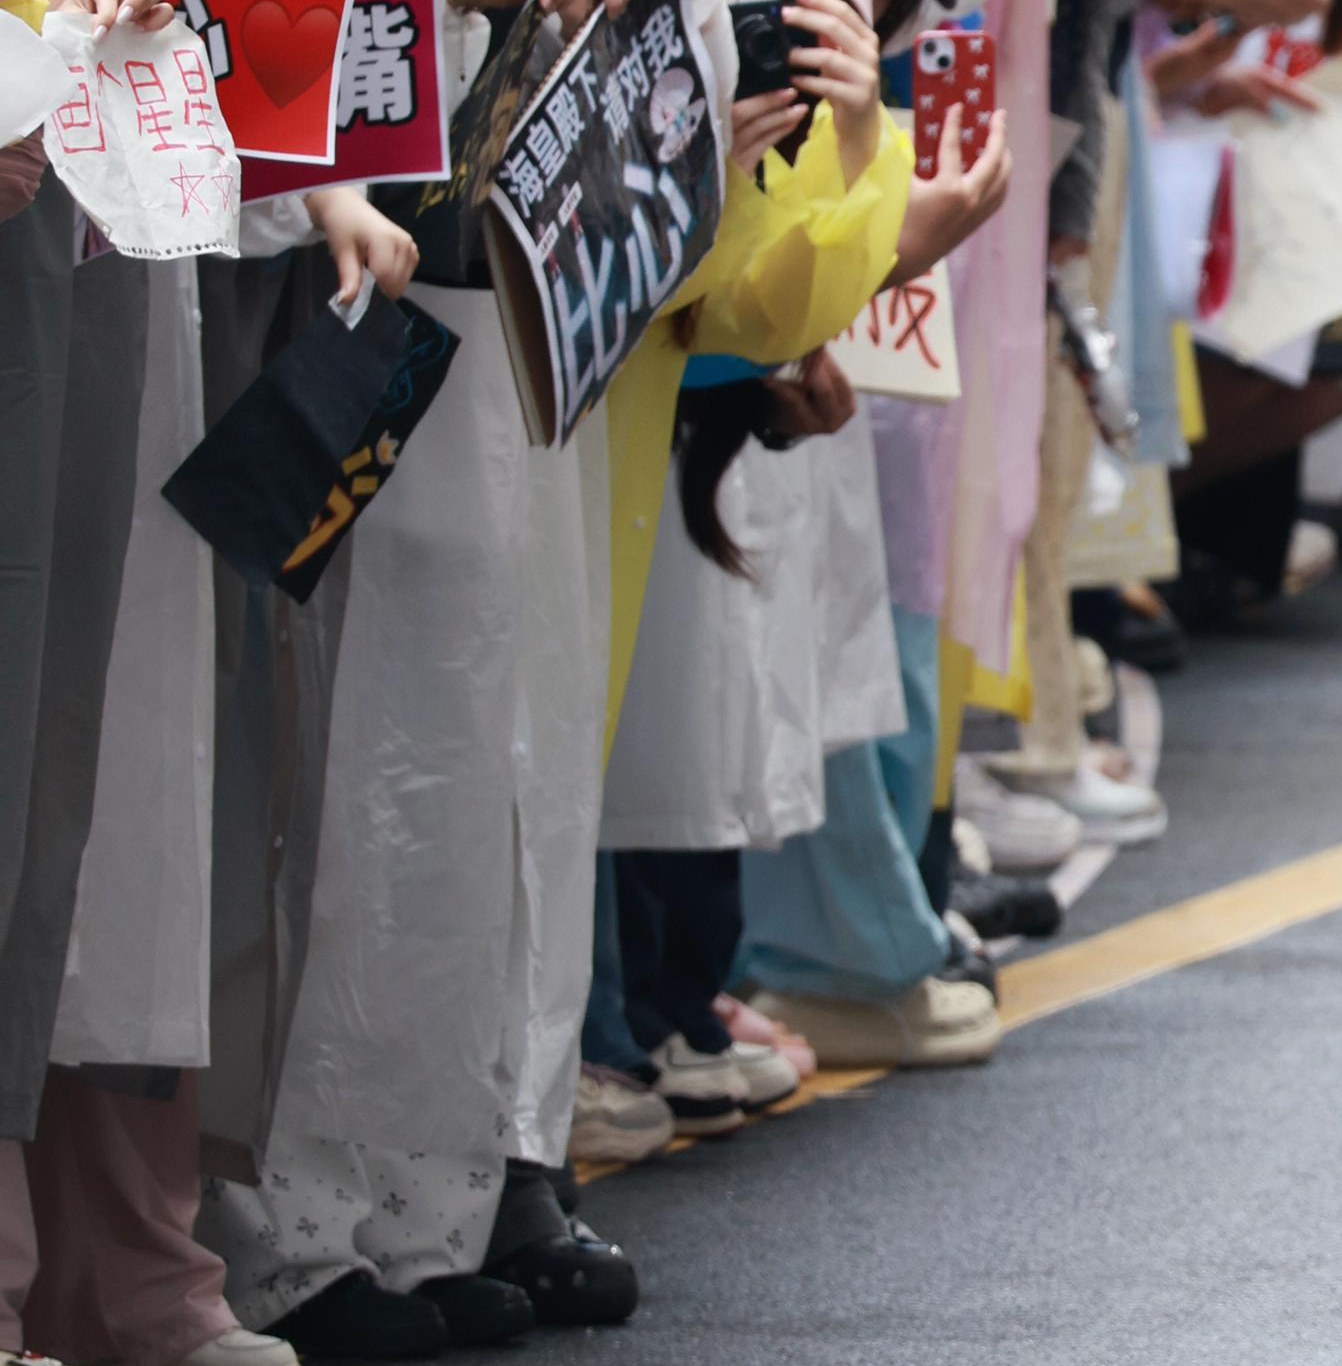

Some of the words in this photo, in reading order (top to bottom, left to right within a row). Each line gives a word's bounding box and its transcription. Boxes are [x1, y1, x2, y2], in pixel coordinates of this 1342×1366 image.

[499, 50, 598, 217] 海皇殿下
[600, 4, 684, 146] 请对我
